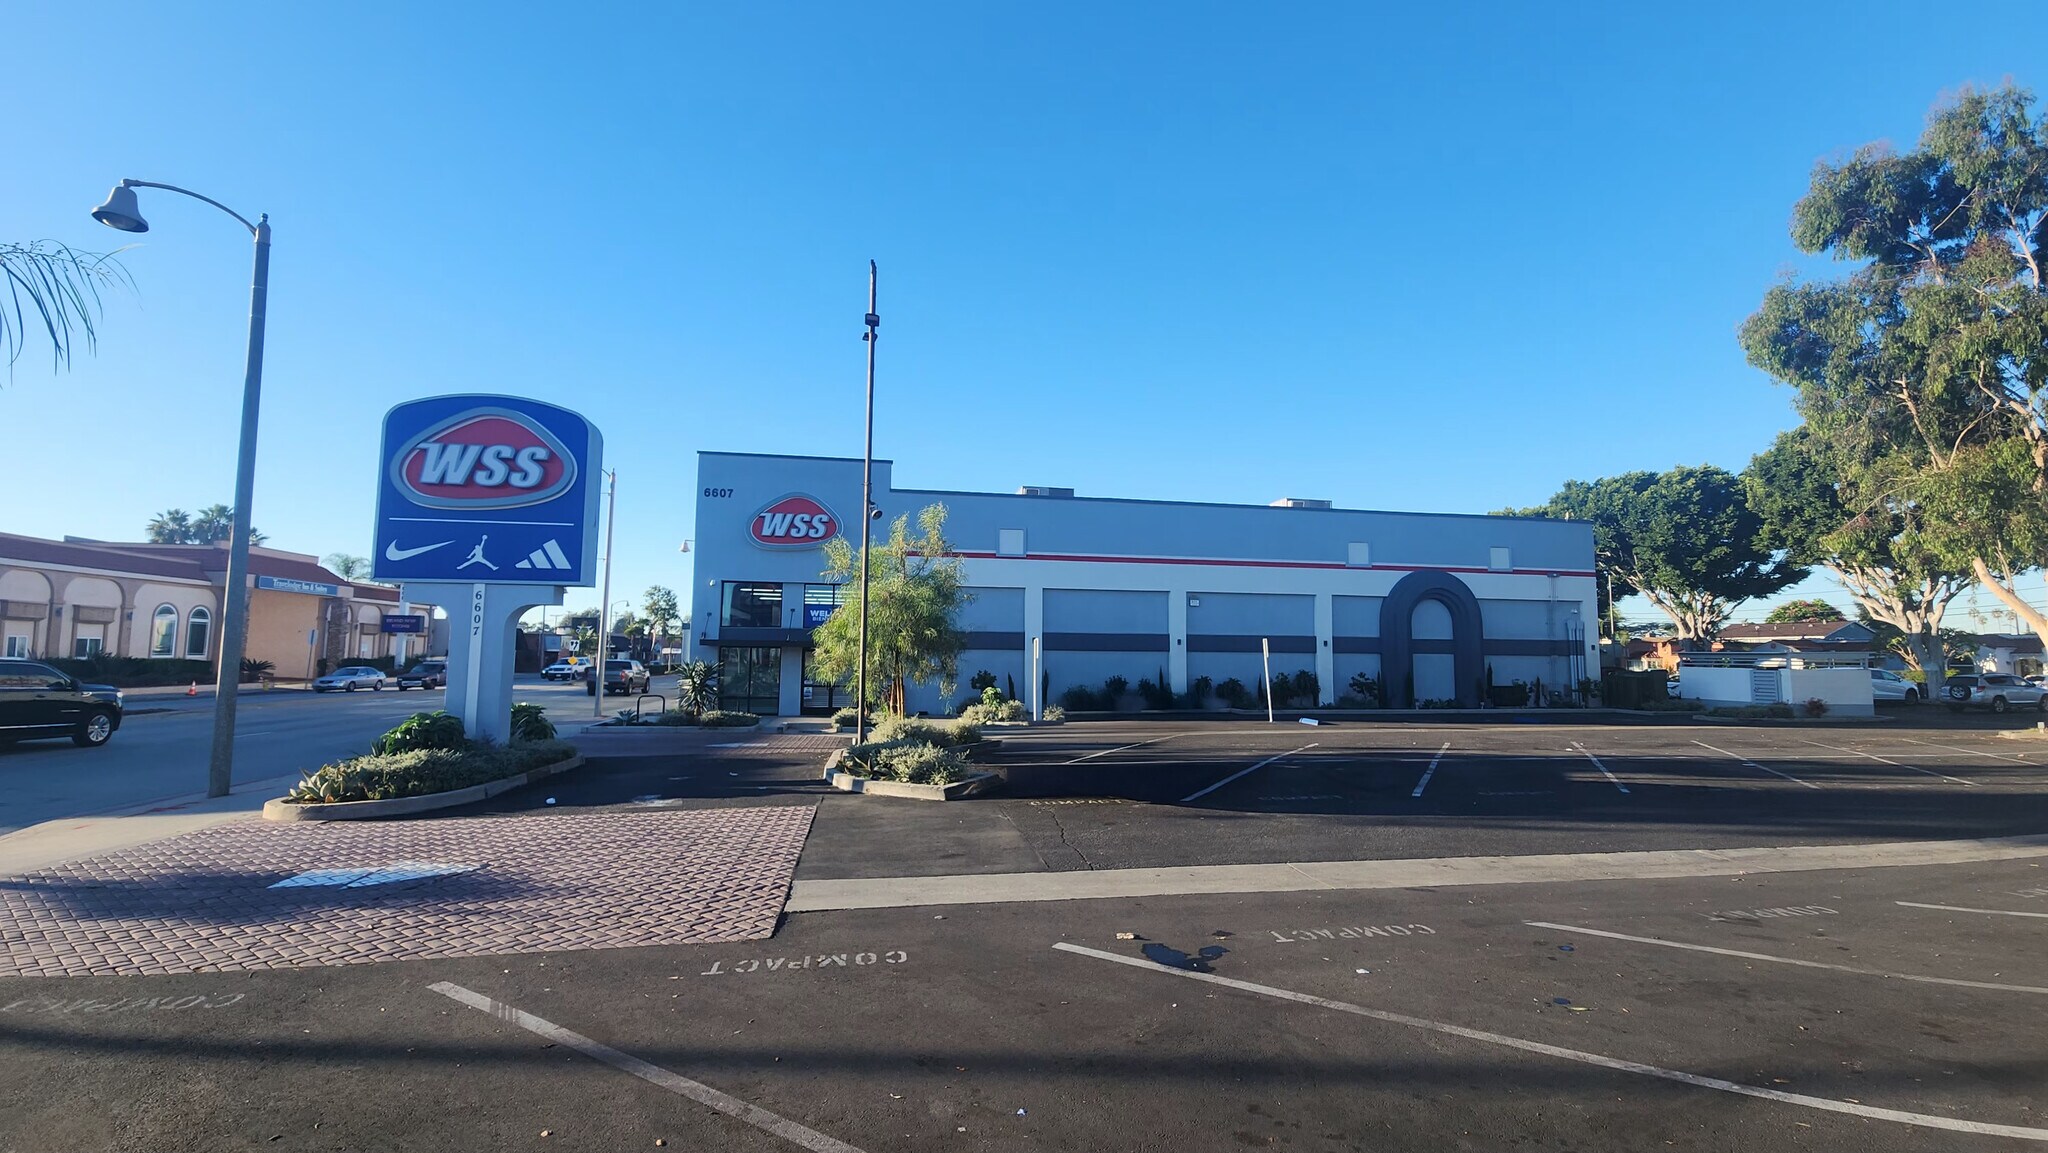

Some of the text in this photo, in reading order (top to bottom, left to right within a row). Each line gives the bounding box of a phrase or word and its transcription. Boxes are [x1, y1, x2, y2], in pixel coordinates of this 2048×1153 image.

[415, 442, 550, 488] WSS
[704, 487, 734, 498] 6607
[759, 512, 830, 538] WSS
[473, 590, 482, 636] 6607
[1269, 923, 1436, 943] COMPACT
[700, 950, 908, 975] COMPACT
